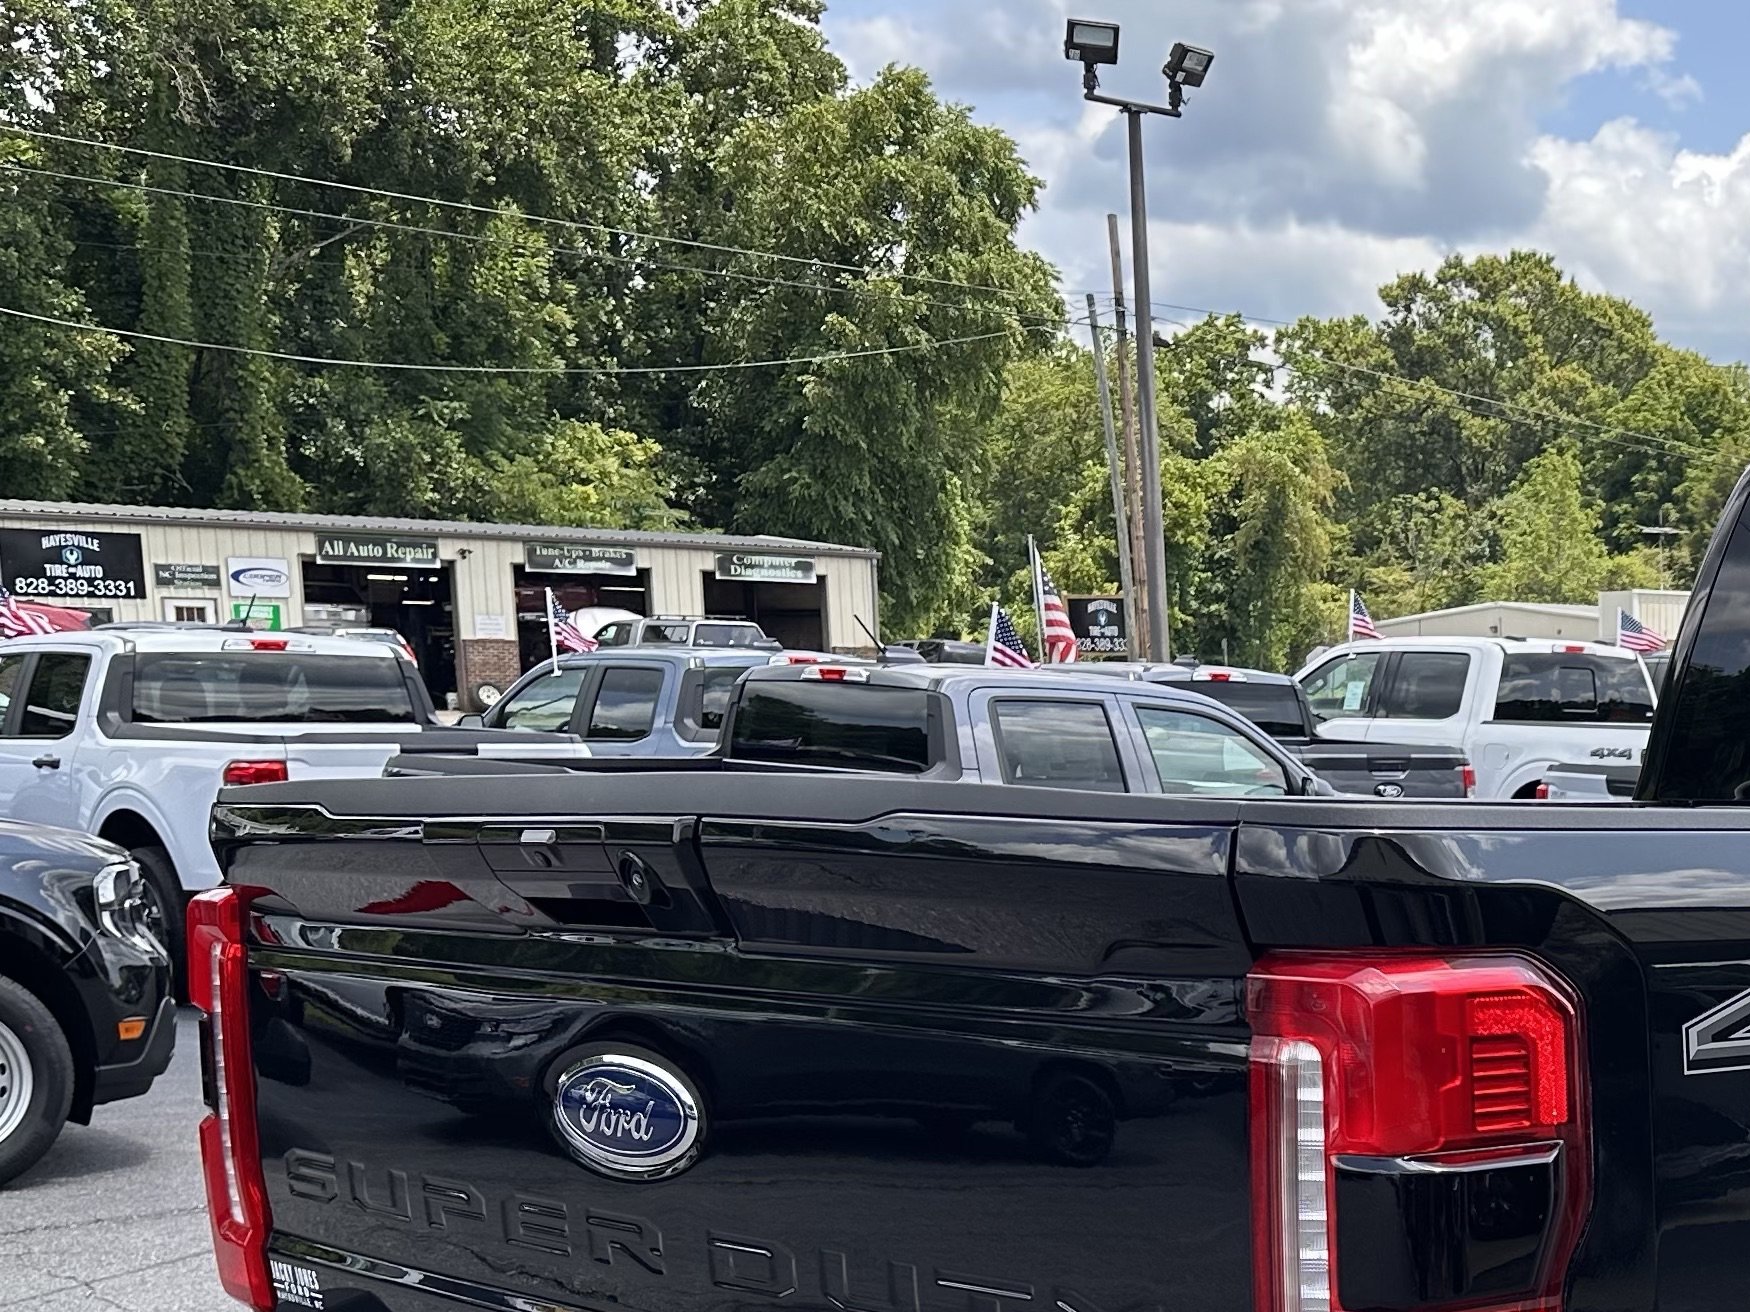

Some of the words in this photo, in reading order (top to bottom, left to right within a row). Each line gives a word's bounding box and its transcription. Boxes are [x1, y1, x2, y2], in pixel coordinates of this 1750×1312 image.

[41, 533, 101, 551] HAYESVILLE
[321, 540, 343, 556] All
[347, 541, 383, 557] Auto
[386, 542, 435, 562] Repair
[552, 558, 575, 569] A/C
[15, 577, 135, 597] 828-389-3331
[579, 1077, 655, 1142] Ford
[284, 1147, 666, 1276] SUPER
